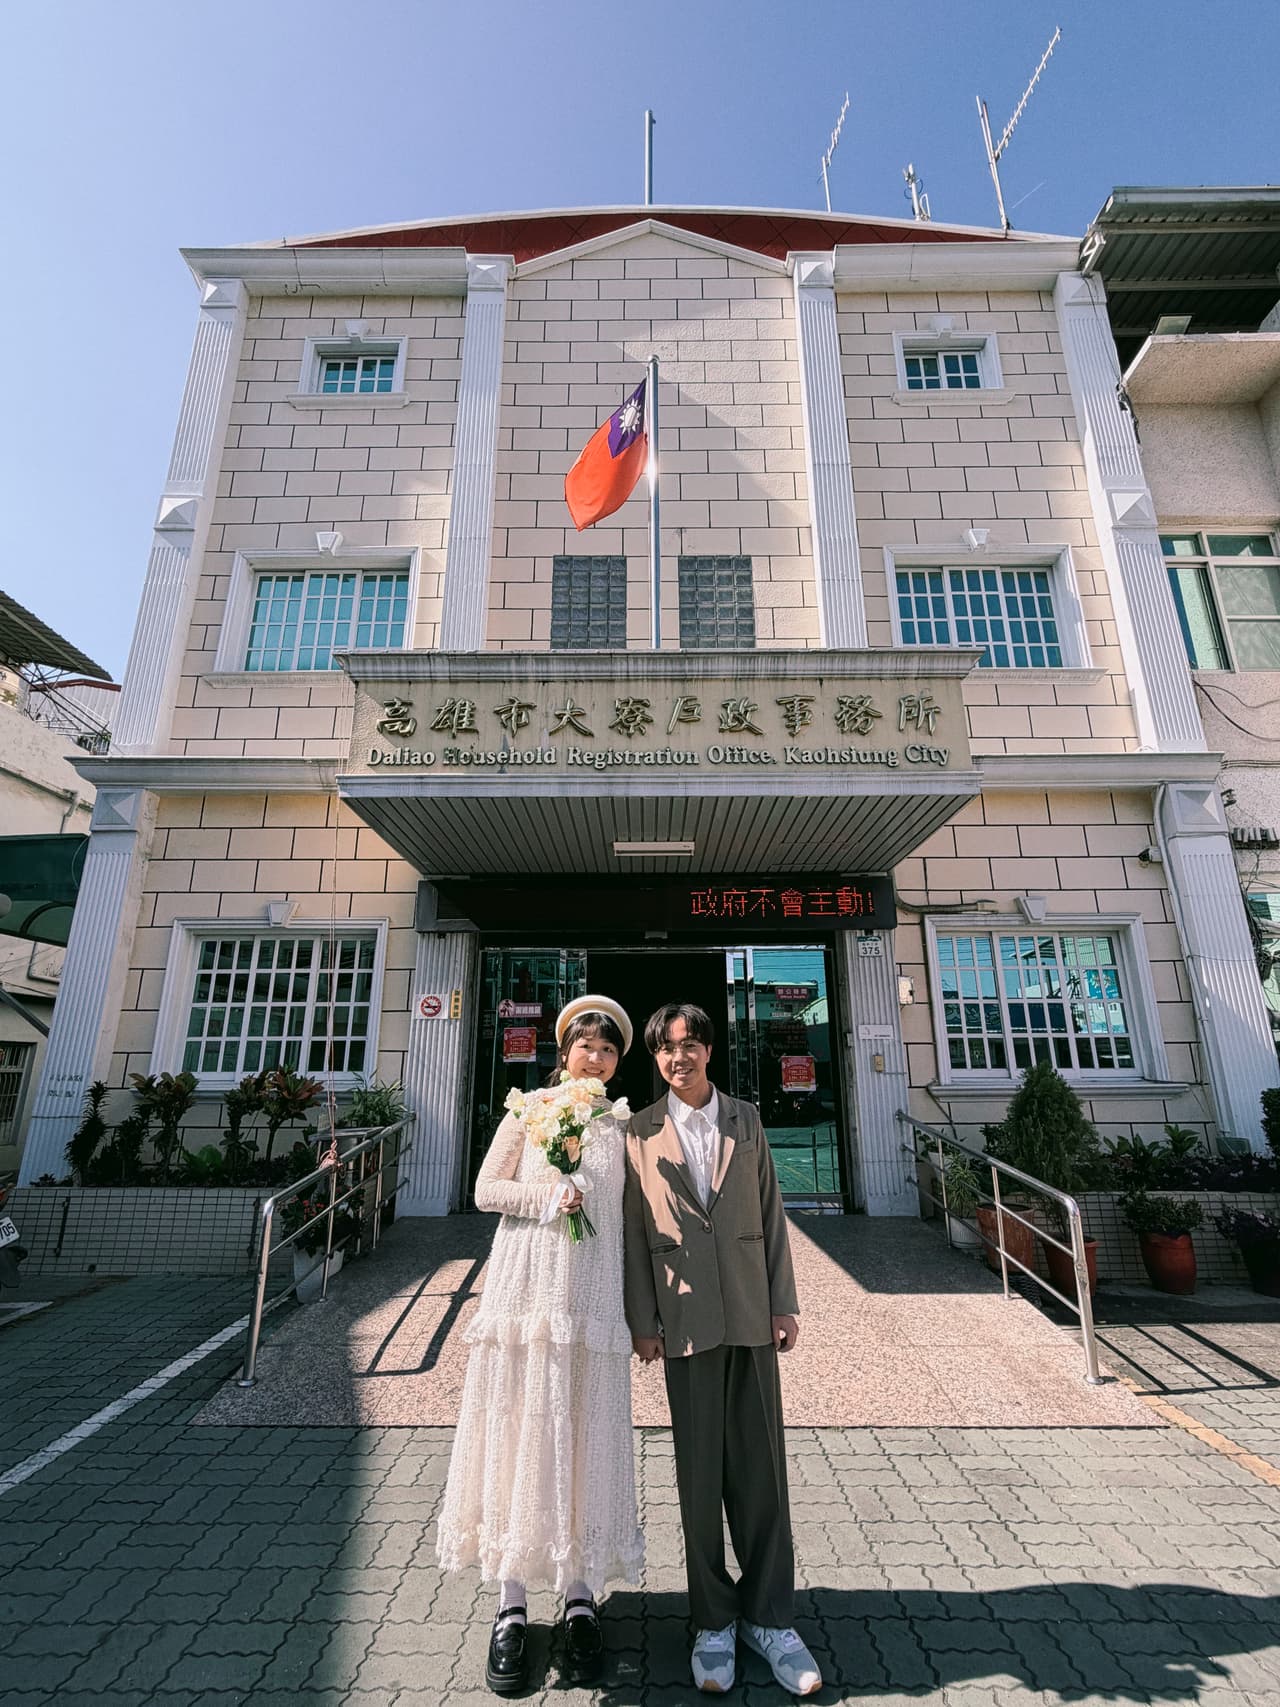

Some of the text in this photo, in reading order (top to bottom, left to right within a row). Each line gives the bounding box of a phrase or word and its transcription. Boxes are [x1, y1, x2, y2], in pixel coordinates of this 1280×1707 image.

[367, 746, 436, 767] Daliao
[443, 746, 557, 767] Household
[567, 746, 700, 769] Registration
[784, 745, 900, 768] Kaohsiung
[905, 744, 950, 767] City
[861, 946, 881, 955] 375
